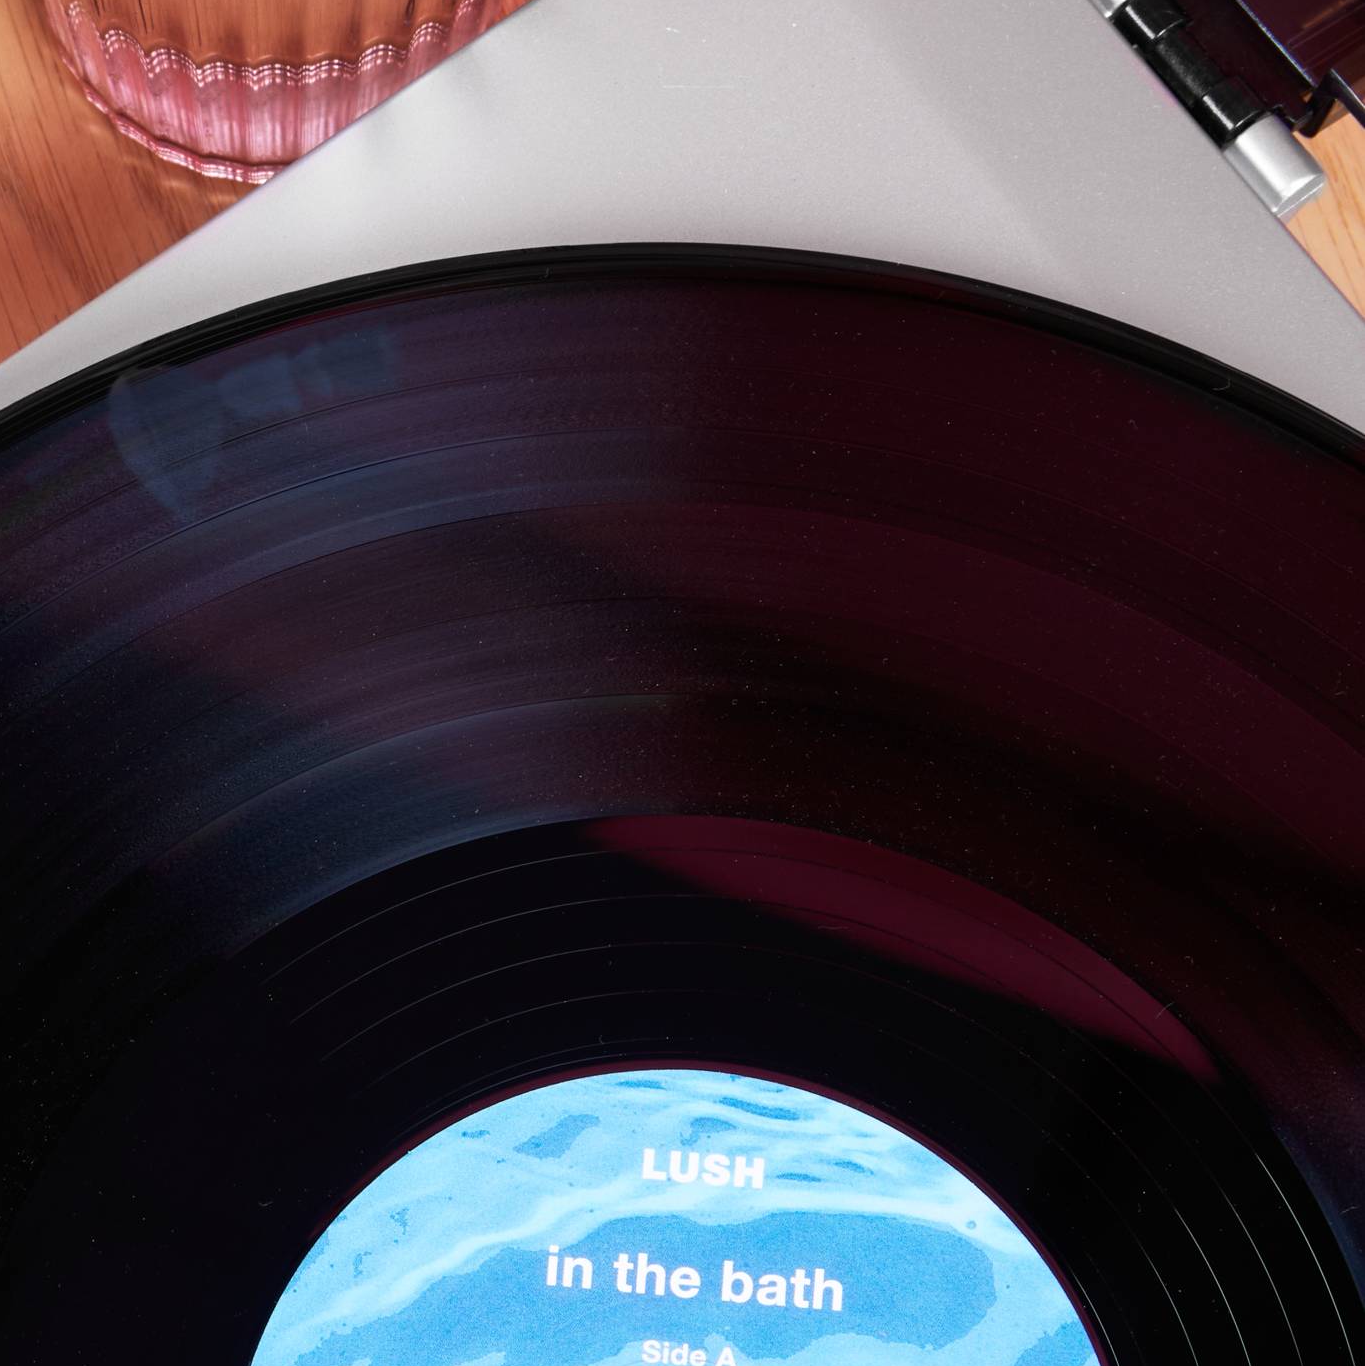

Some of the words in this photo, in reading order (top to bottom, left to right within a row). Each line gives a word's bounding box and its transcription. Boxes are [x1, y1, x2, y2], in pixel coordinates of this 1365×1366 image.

[641, 1147, 766, 1190] LUSH
[545, 1244, 595, 1290] in
[612, 1250, 702, 1301] the
[720, 1258, 845, 1312] bath
